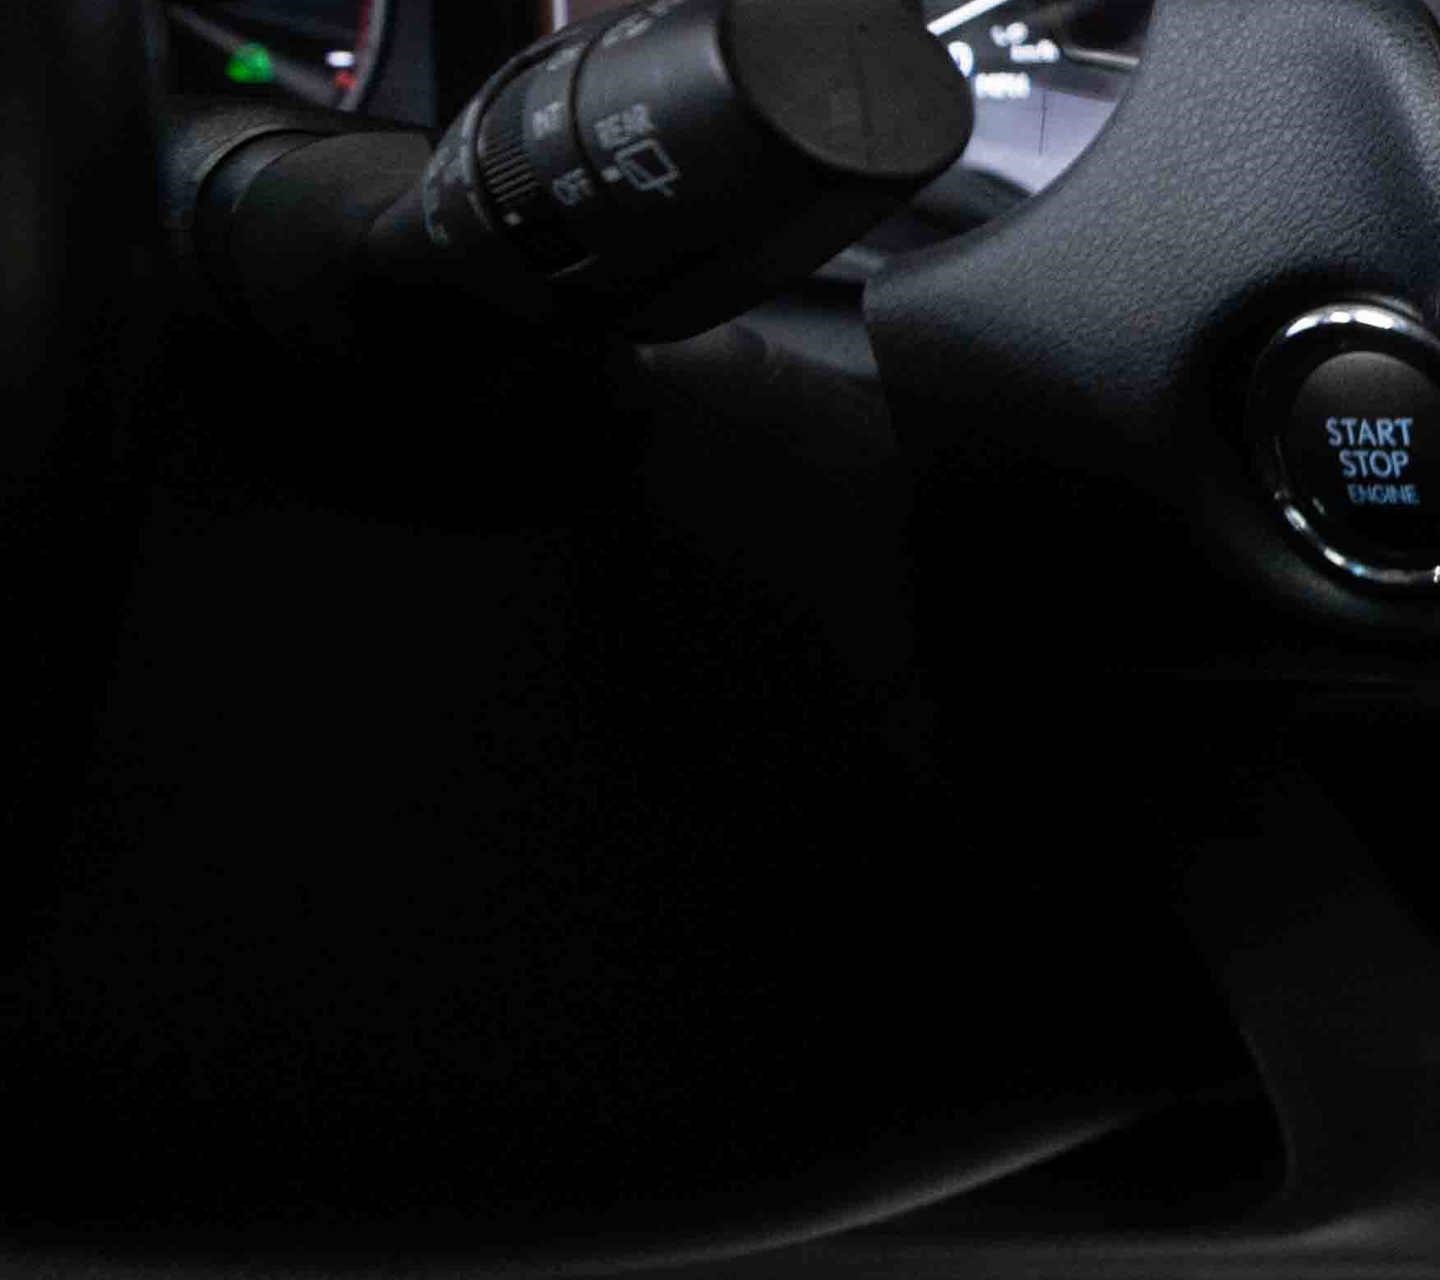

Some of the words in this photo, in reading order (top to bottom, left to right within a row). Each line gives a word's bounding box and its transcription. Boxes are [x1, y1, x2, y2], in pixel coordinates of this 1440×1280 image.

[1326, 417, 1413, 446] START
[1339, 450, 1409, 478] STOP
[1348, 483, 1419, 505] ENGINE
